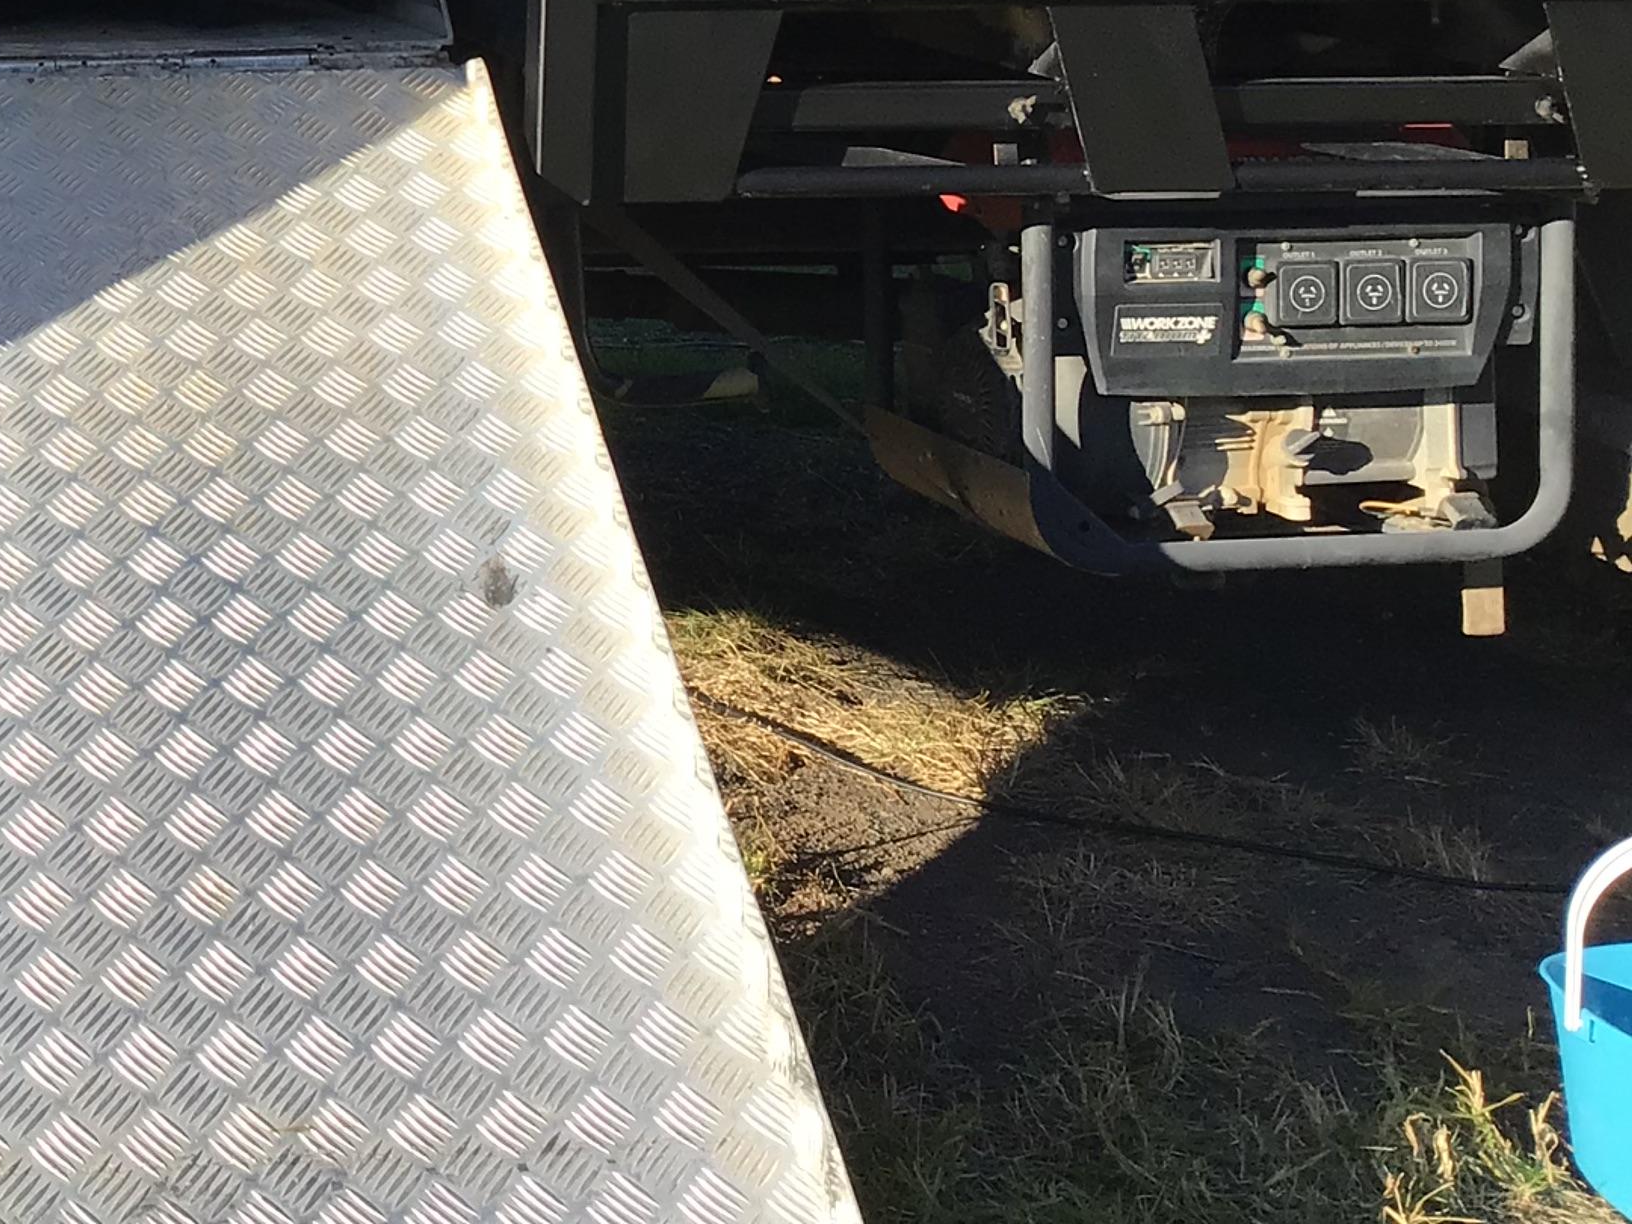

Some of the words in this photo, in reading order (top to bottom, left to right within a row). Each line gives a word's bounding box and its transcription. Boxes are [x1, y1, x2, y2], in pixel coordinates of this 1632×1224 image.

[1282, 251, 1309, 259] OUTLET
[1349, 249, 1375, 257] OUTLET
[1414, 248, 1442, 256] OUTLET
[1131, 316, 1219, 330] WORKZONE
